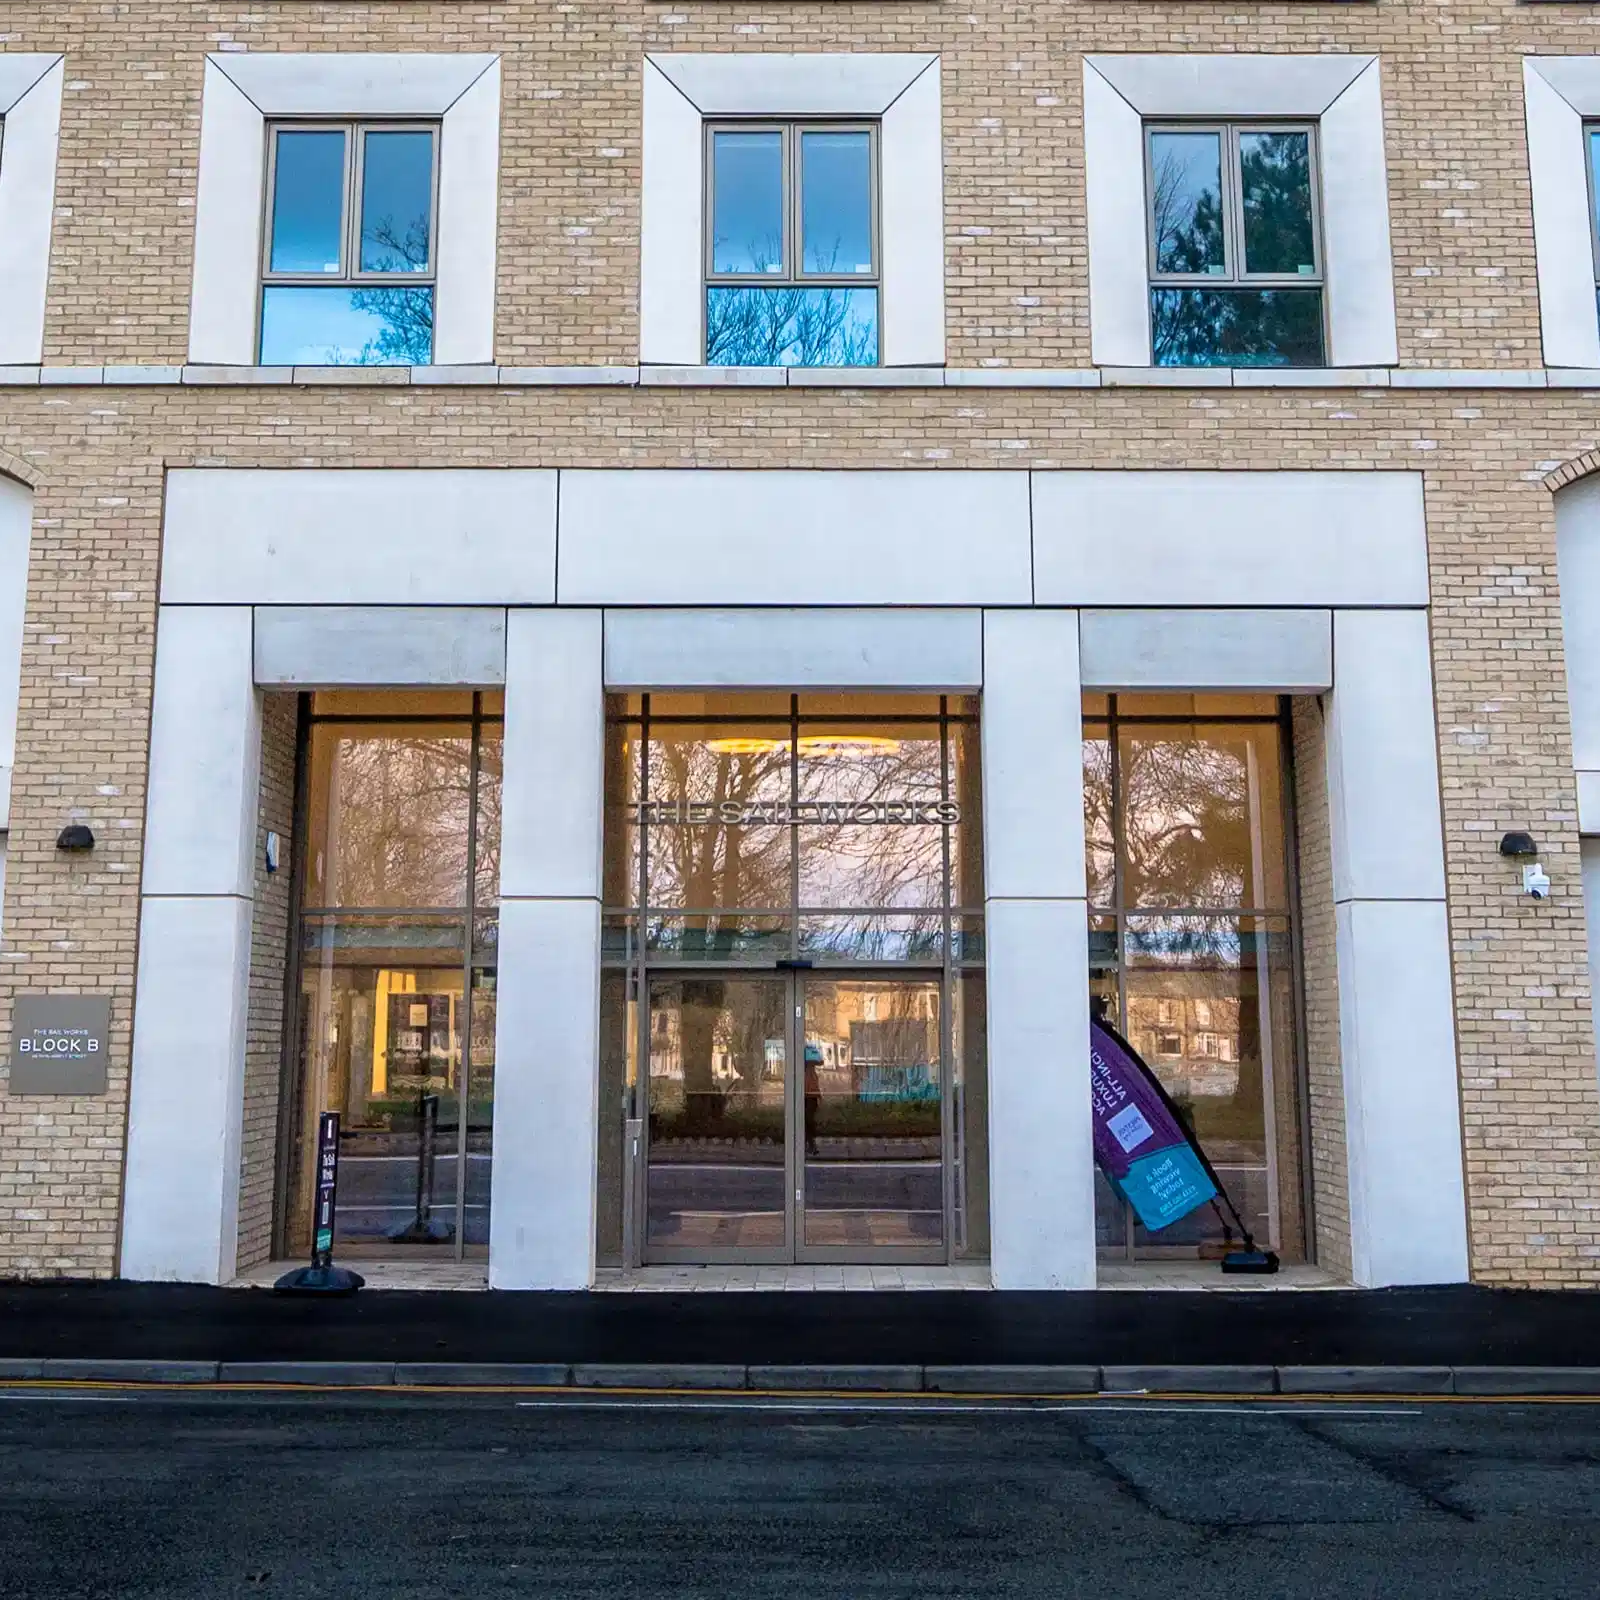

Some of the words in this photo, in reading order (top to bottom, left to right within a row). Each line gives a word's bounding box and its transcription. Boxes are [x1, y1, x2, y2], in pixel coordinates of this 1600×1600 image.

[631, 800, 708, 824] THE
[719, 800, 804, 824] SAIL
[815, 801, 961, 824] WORKS
[19, 1038, 81, 1052] BLOCK
[87, 1038, 99, 1052] B
